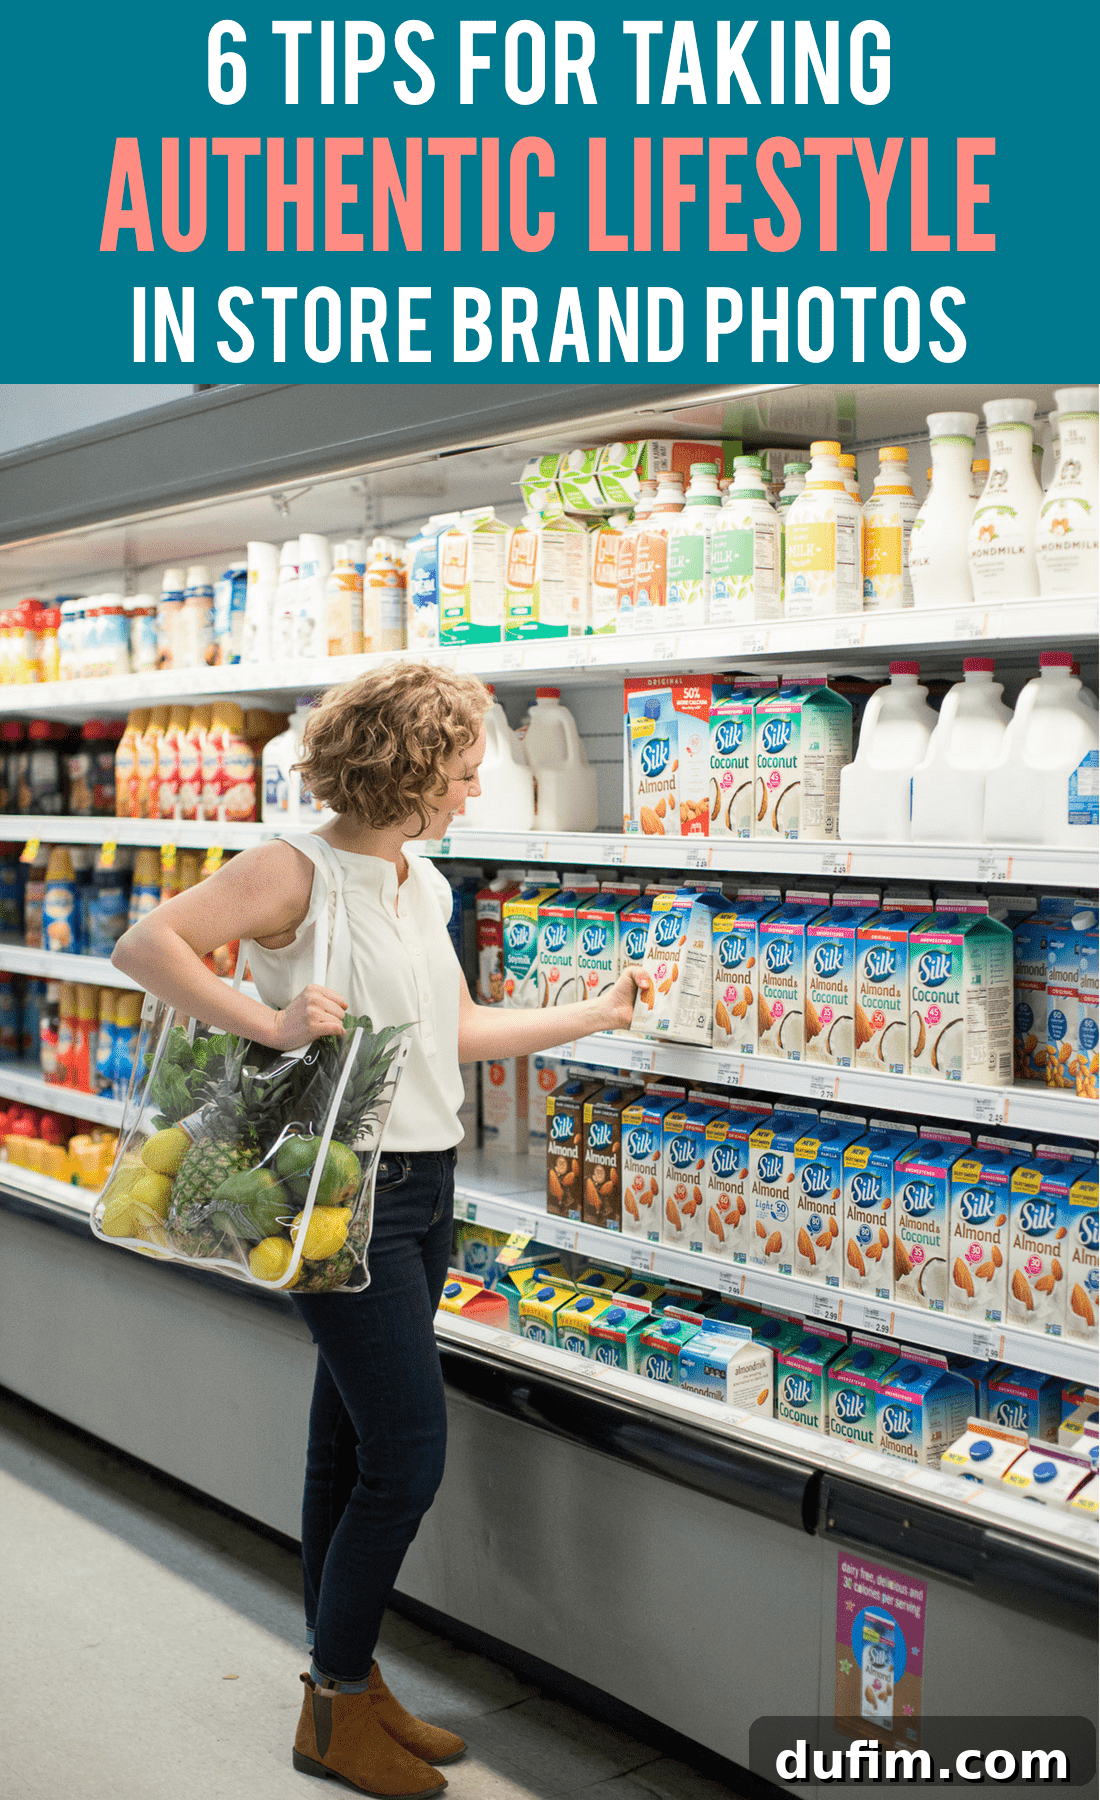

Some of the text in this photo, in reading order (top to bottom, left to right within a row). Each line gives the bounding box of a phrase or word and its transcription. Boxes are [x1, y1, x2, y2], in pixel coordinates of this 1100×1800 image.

[683, 688, 701, 699] 50%
[715, 723, 743, 754] Silk
[762, 722, 791, 753] Silk
[641, 742, 669, 776] Silk
[710, 755, 749, 769] Coconut
[757, 755, 798, 769] Coconut
[638, 775, 676, 795] Almond
[509, 926, 530, 947] Silk
[544, 925, 567, 948] Silk
[582, 928, 607, 952] Silk
[654, 918, 679, 943] Silk
[540, 952, 572, 966] Coconut
[647, 947, 680, 961] Almond
[718, 940, 746, 965] Silk
[765, 943, 793, 971] Silk
[814, 947, 843, 975] Silk
[578, 955, 612, 970] Coconut
[864, 952, 895, 979] Silk
[918, 955, 952, 982] Silk
[716, 969, 752, 984] Almond
[763, 973, 793, 987] Almond
[810, 977, 843, 992] Almond
[764, 985, 798, 1000] Coconut
[812, 990, 848, 1005] Coconut
[860, 982, 895, 998] Almond
[912, 987, 960, 1004] Coconut
[862, 995, 901, 1011] Coconut
[929, 1008, 939, 1017] 45
[875, 1014, 883, 1022] 50
[727, 1076, 739, 1084] 2.79
[820, 1090, 834, 1098] 2.79
[551, 1116, 573, 1140] Silk
[588, 1123, 612, 1148] Silk
[548, 1141, 579, 1159] Almond
[627, 1131, 652, 1158] Silk
[669, 1138, 696, 1166] Silk
[585, 1149, 617, 1168] Almond
[624, 1158, 657, 1176] Almond
[712, 1147, 739, 1176] Silk
[758, 1156, 783, 1179] Silk
[666, 1167, 701, 1185] Almond
[708, 1176, 744, 1195] Almond
[801, 1167, 831, 1194] Silk
[752, 1181, 790, 1200] Almond
[851, 1177, 882, 1204] Silk
[902, 1185, 935, 1212] Silk
[755, 1199, 773, 1211] Light
[776, 1205, 786, 1213] 50
[798, 1196, 836, 1216] Almond
[960, 1192, 995, 1220] Silk
[811, 1218, 820, 1226] 80
[847, 1206, 887, 1226] Almond
[899, 1215, 935, 1233] Almond
[1019, 1202, 1056, 1232] Silk
[860, 1228, 870, 1236] 80
[901, 1229, 941, 1246] Coconut
[954, 1223, 1001, 1244] Almond
[914, 1250, 923, 1258] 35
[971, 1247, 981, 1255] 30
[1013, 1234, 1061, 1257] Almond
[1030, 1259, 1040, 1268] 30
[825, 1311, 838, 1321] 2.99
[876, 1323, 889, 1334] 2.99
[985, 1348, 998, 1358] 2.99
[646, 1356, 672, 1381] Silk
[735, 1360, 766, 1375] almondmilk
[783, 1377, 812, 1407] Silk
[780, 1403, 819, 1428] Coconut
[835, 1392, 866, 1422] Silk
[997, 1402, 1029, 1430] Silk
[882, 1406, 913, 1435] Silk
[831, 1418, 874, 1444] Coconut
[880, 1436, 913, 1454] Almond
[841, 1561, 859, 1579] dairy
[877, 1575, 908, 1596] delicious
[909, 1587, 923, 1601] and
[854, 1583, 881, 1600] calories
[895, 1598, 921, 1619] serving
